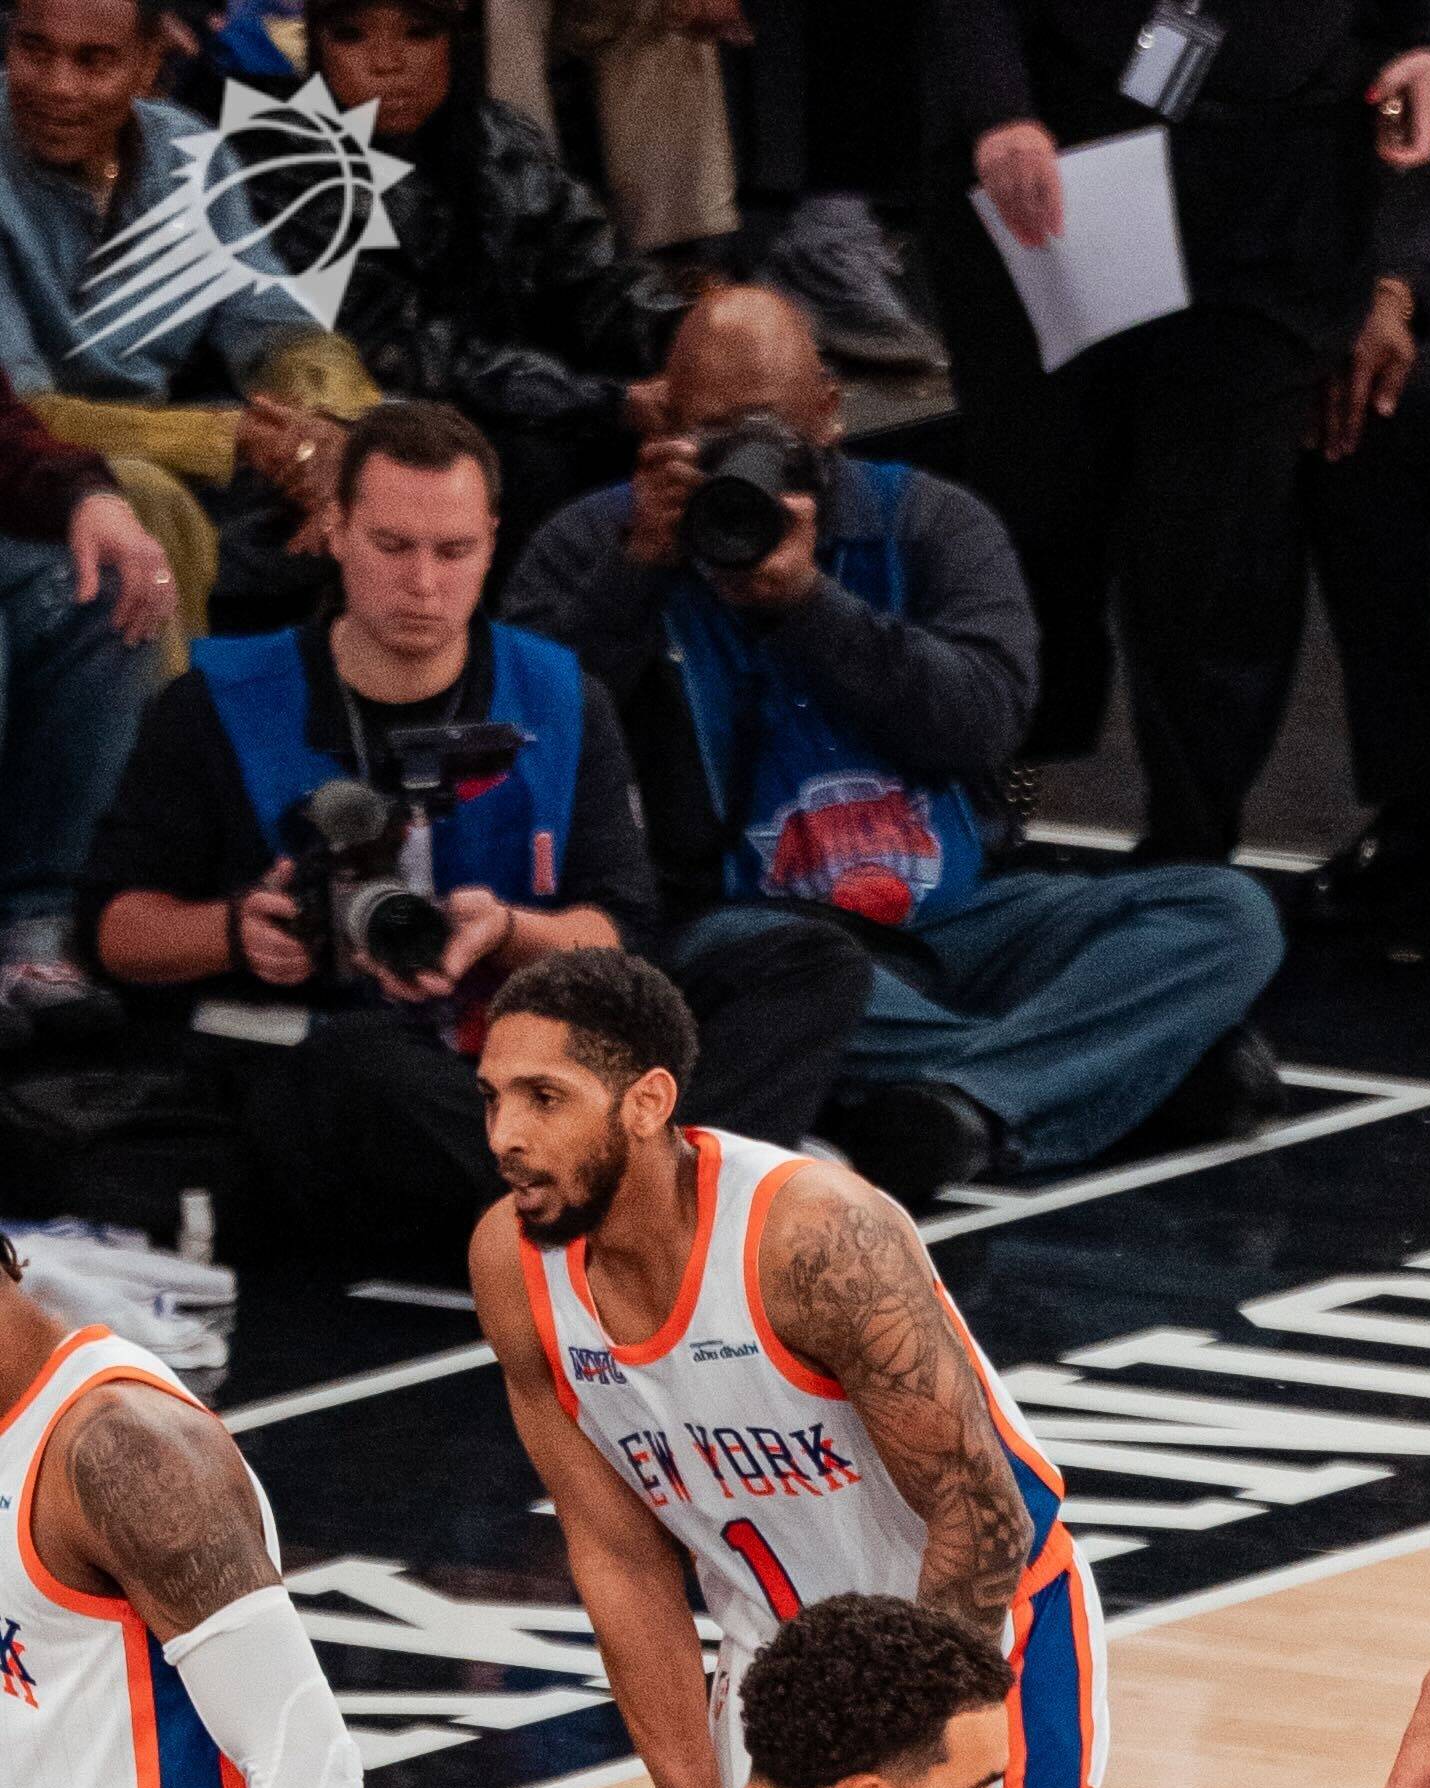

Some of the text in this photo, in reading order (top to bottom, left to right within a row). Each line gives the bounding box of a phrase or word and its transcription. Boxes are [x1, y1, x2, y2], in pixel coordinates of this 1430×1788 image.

[617, 1422, 862, 1508] EW YORK
[720, 1517, 805, 1623] 1
